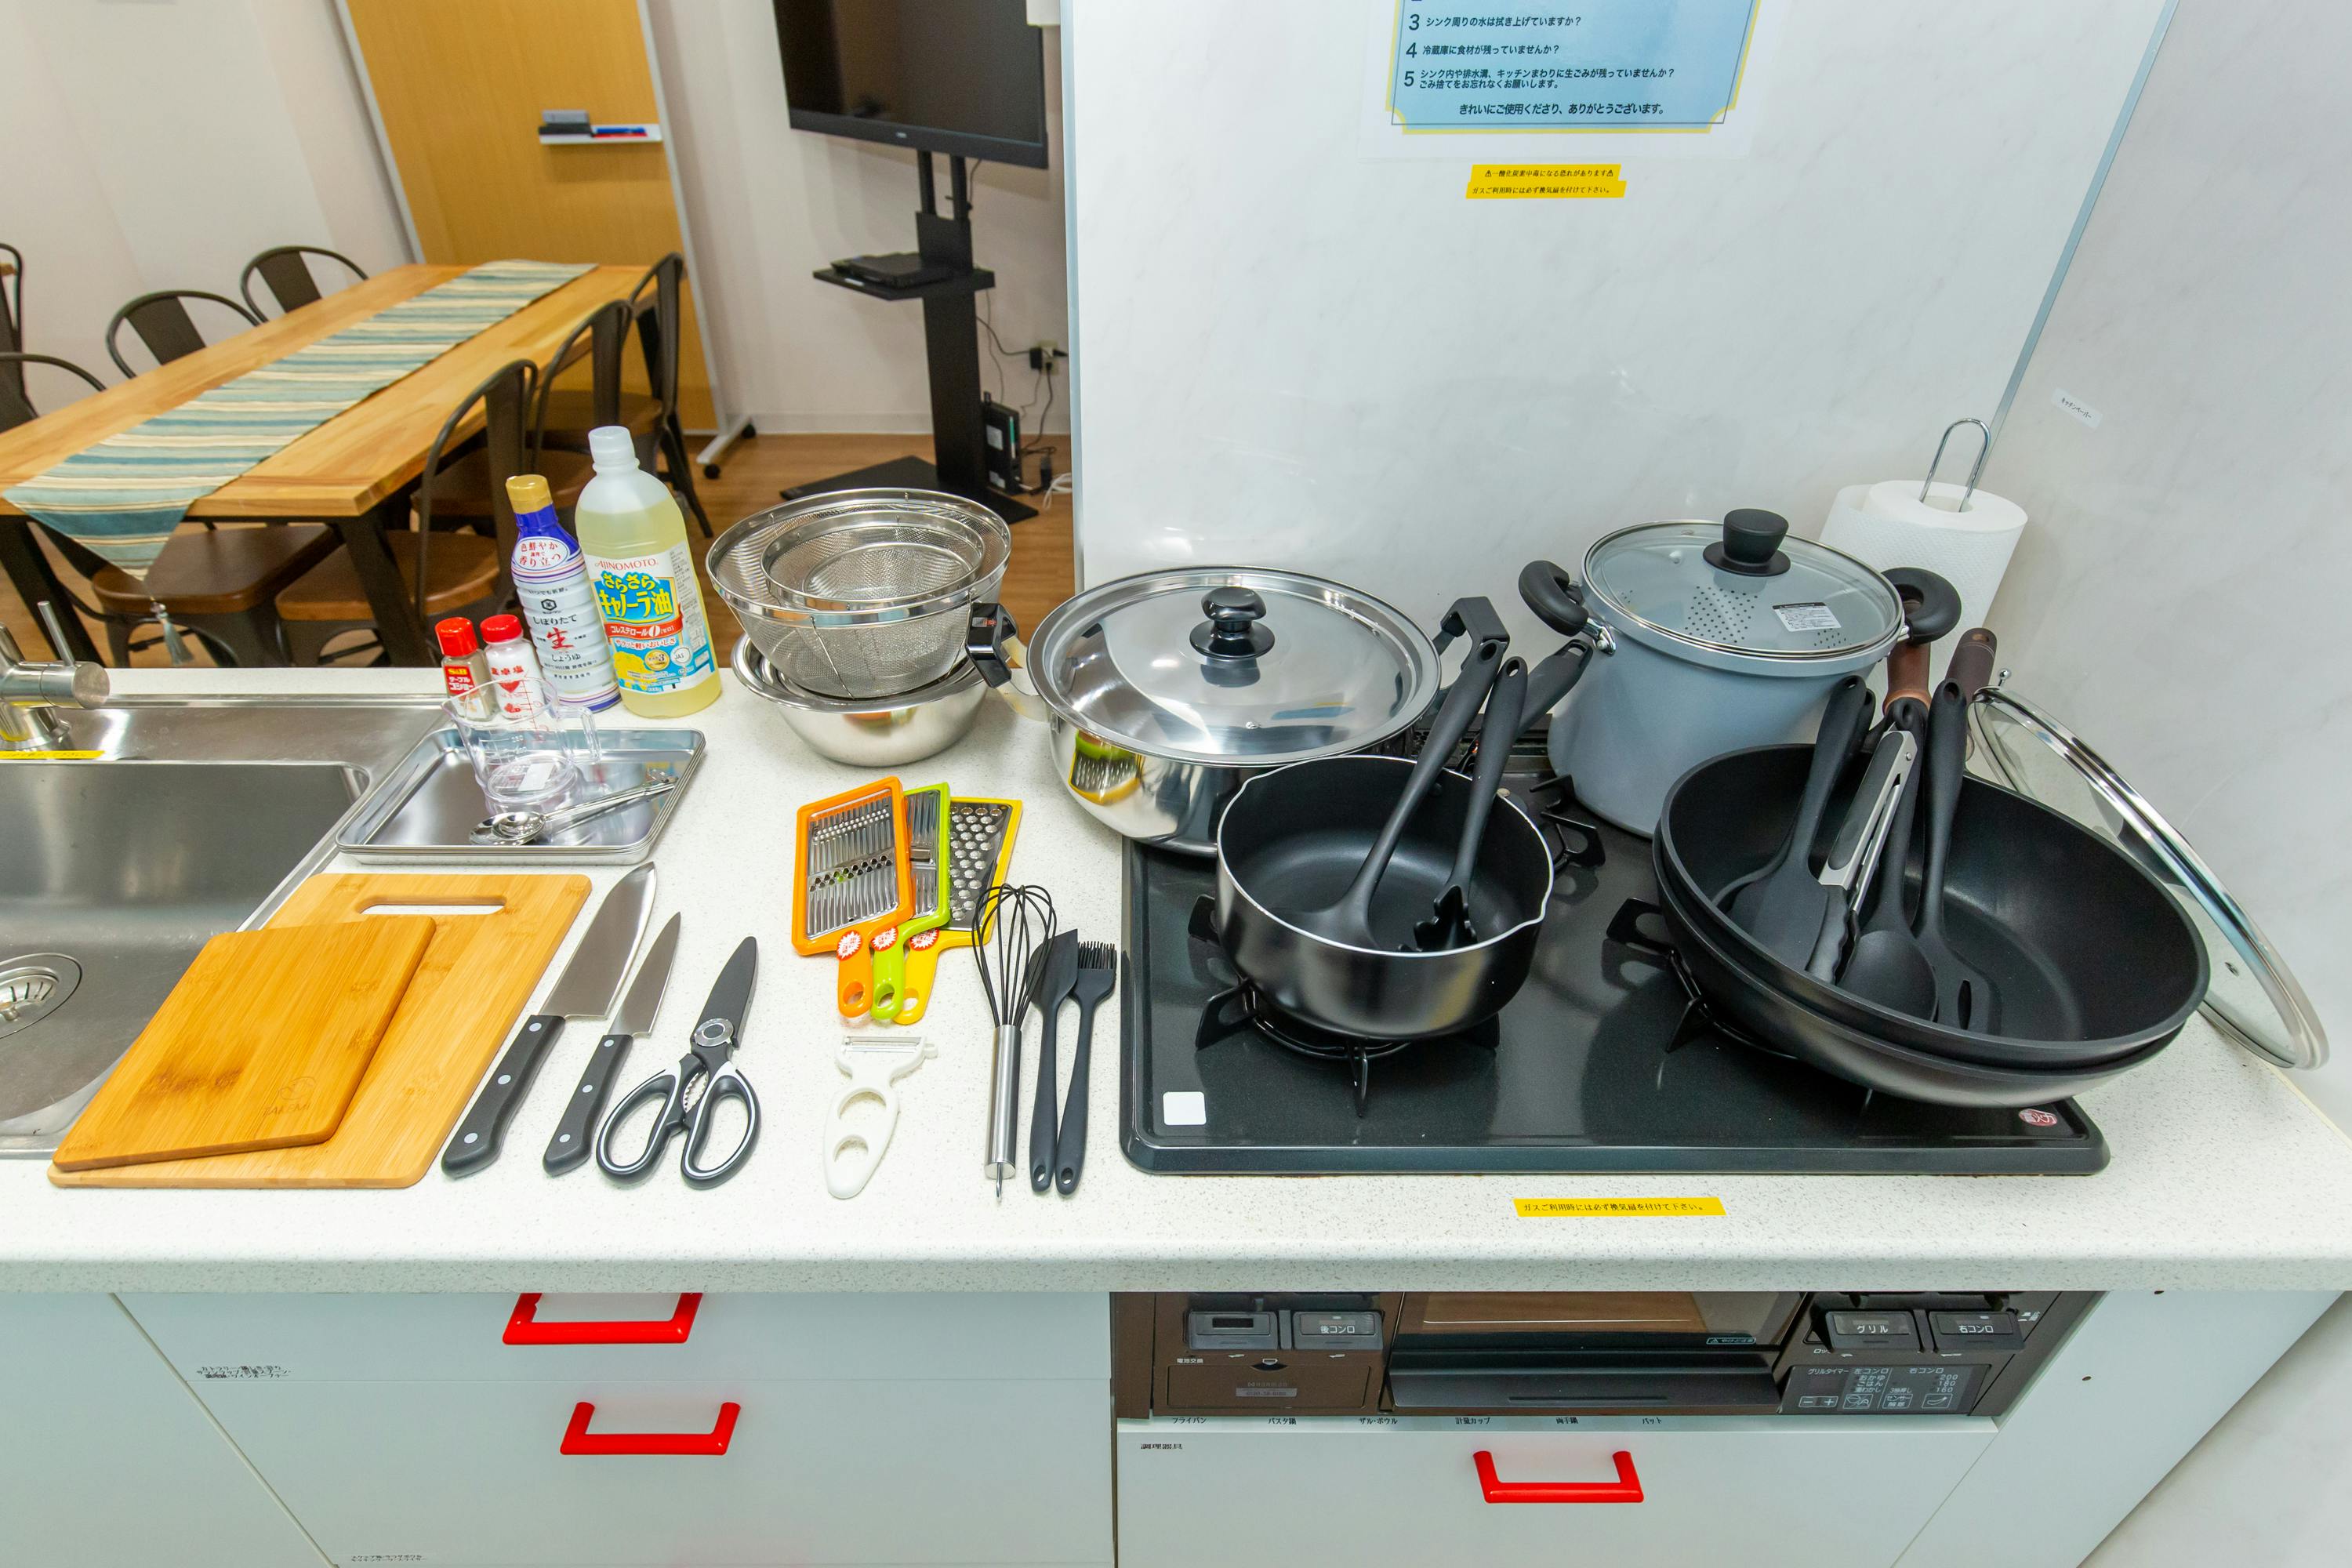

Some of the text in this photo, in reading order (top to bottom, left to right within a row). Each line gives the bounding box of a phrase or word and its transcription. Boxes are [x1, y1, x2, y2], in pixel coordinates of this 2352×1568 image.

[1409, 14, 1420, 31] 3
[1406, 42, 1417, 58] 4
[1404, 71, 1414, 86] 5
[602, 573, 655, 593] さらさら
[599, 589, 673, 617] キャノーラ油
[533, 614, 577, 626] しぼりたて
[546, 626, 575, 650] 生
[551, 653, 581, 662] しょうゆ
[1320, 1325, 1355, 1334] 後コンロ
